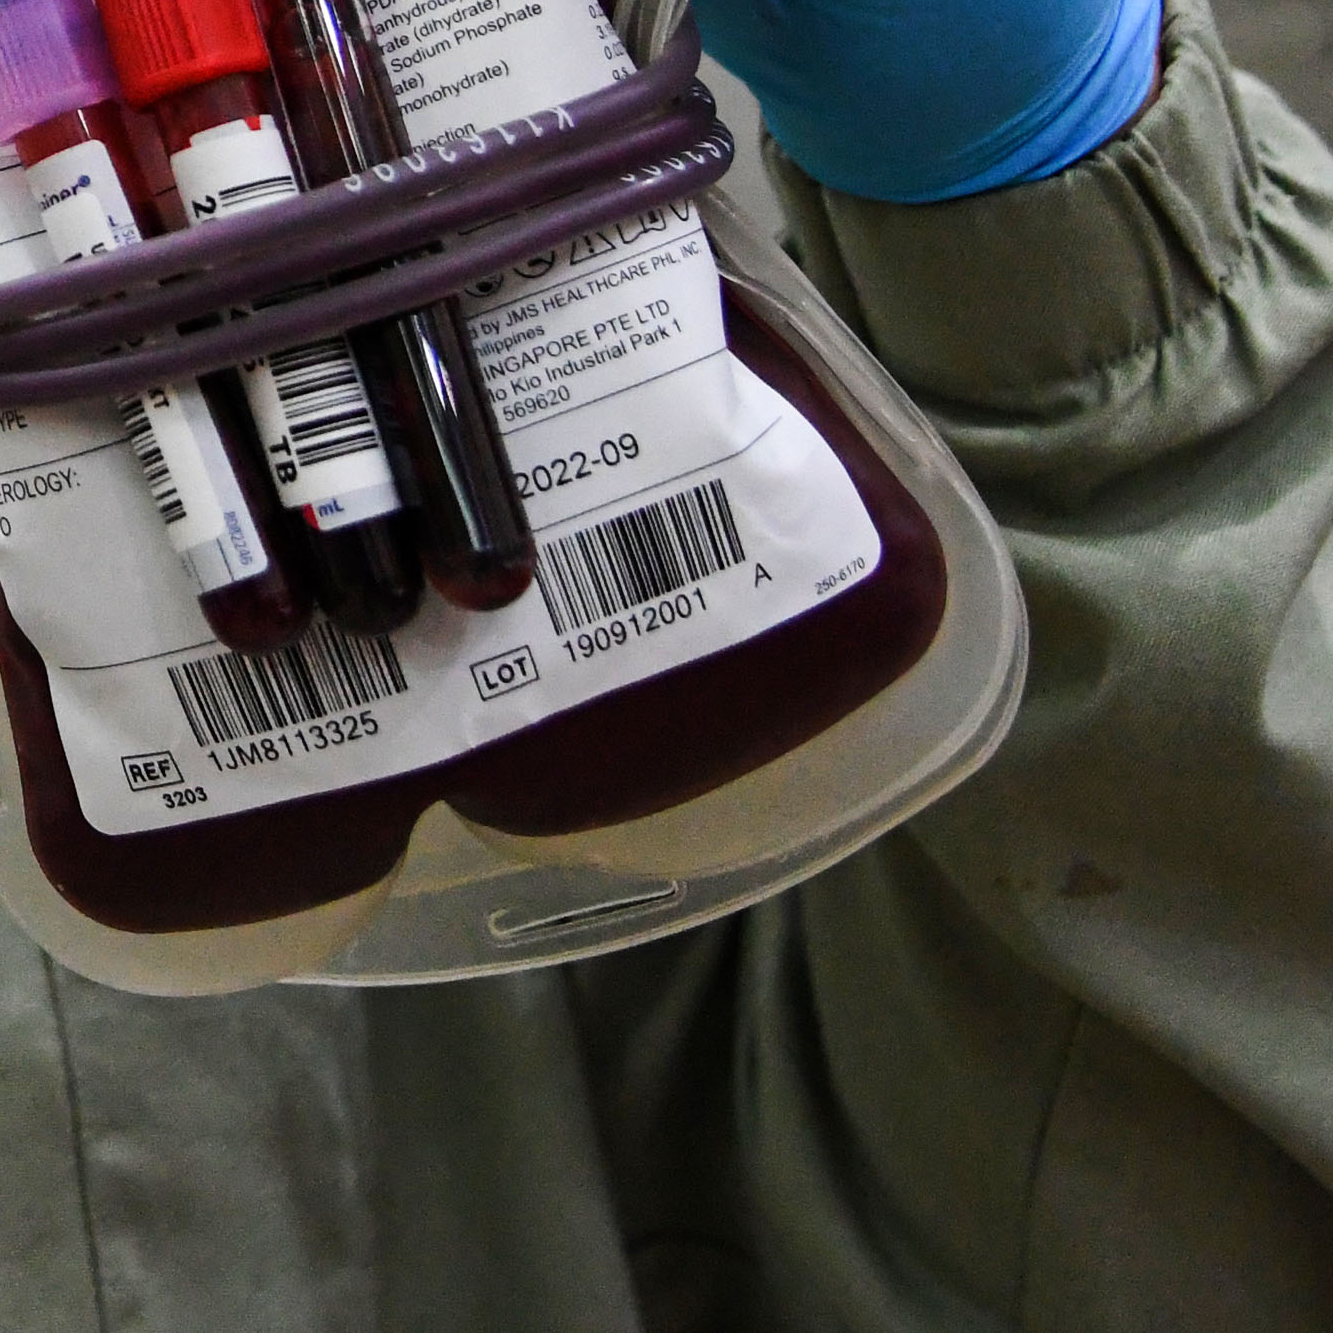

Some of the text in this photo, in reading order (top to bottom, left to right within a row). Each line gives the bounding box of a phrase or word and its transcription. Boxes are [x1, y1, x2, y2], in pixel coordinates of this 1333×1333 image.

[391, 2, 543, 73] Sodium Phosphate
[506, 303, 539, 328] JMS
[542, 260, 650, 313] HEALTHCARE
[683, 241, 702, 259] INC.
[593, 313, 633, 341] PTE
[635, 298, 670, 325] LTD
[511, 375, 542, 397] Kio
[545, 340, 627, 382] Industrial
[632, 324, 670, 351] Park
[503, 385, 570, 422] 569620
[515, 432, 640, 499] 2022-09
[561, 563, 772, 663] 190912001 A
[482, 656, 528, 691] LOT
[129, 759, 171, 783] REF
[208, 710, 379, 772] 1JM8113325
[163, 787, 208, 809] 3203
